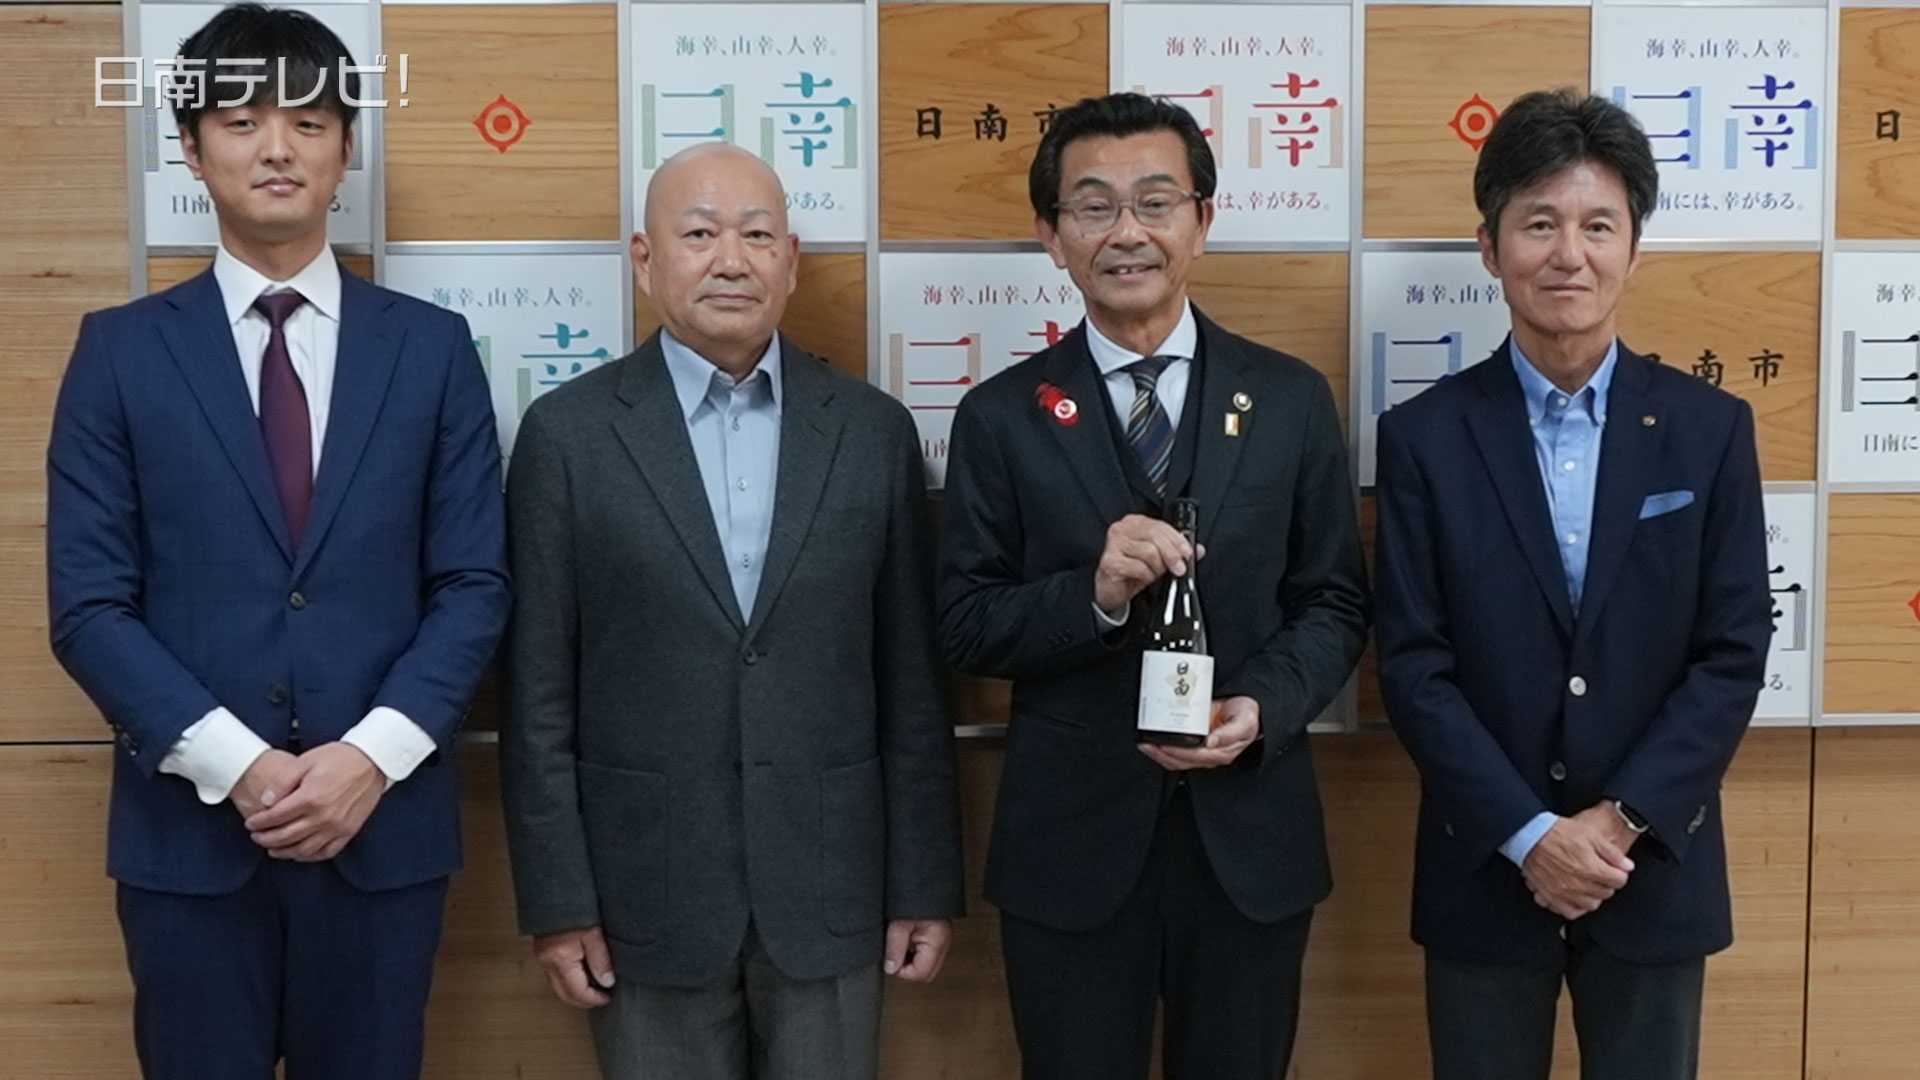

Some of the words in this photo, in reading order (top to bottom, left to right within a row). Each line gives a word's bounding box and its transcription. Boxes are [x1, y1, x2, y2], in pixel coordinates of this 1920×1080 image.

[676, 35, 837, 56] 海幸、山幸、人幸。
[1166, 36, 1324, 57] 海幸、山幸、人幸。
[1646, 38, 1801, 59] 海幸、山幸、人幸。
[1876, 109, 1900, 142] 日
[431, 286, 593, 308] 海幸、山幸、人幸。
[922, 284, 1082, 306] 海幸、山幸、人幸。
